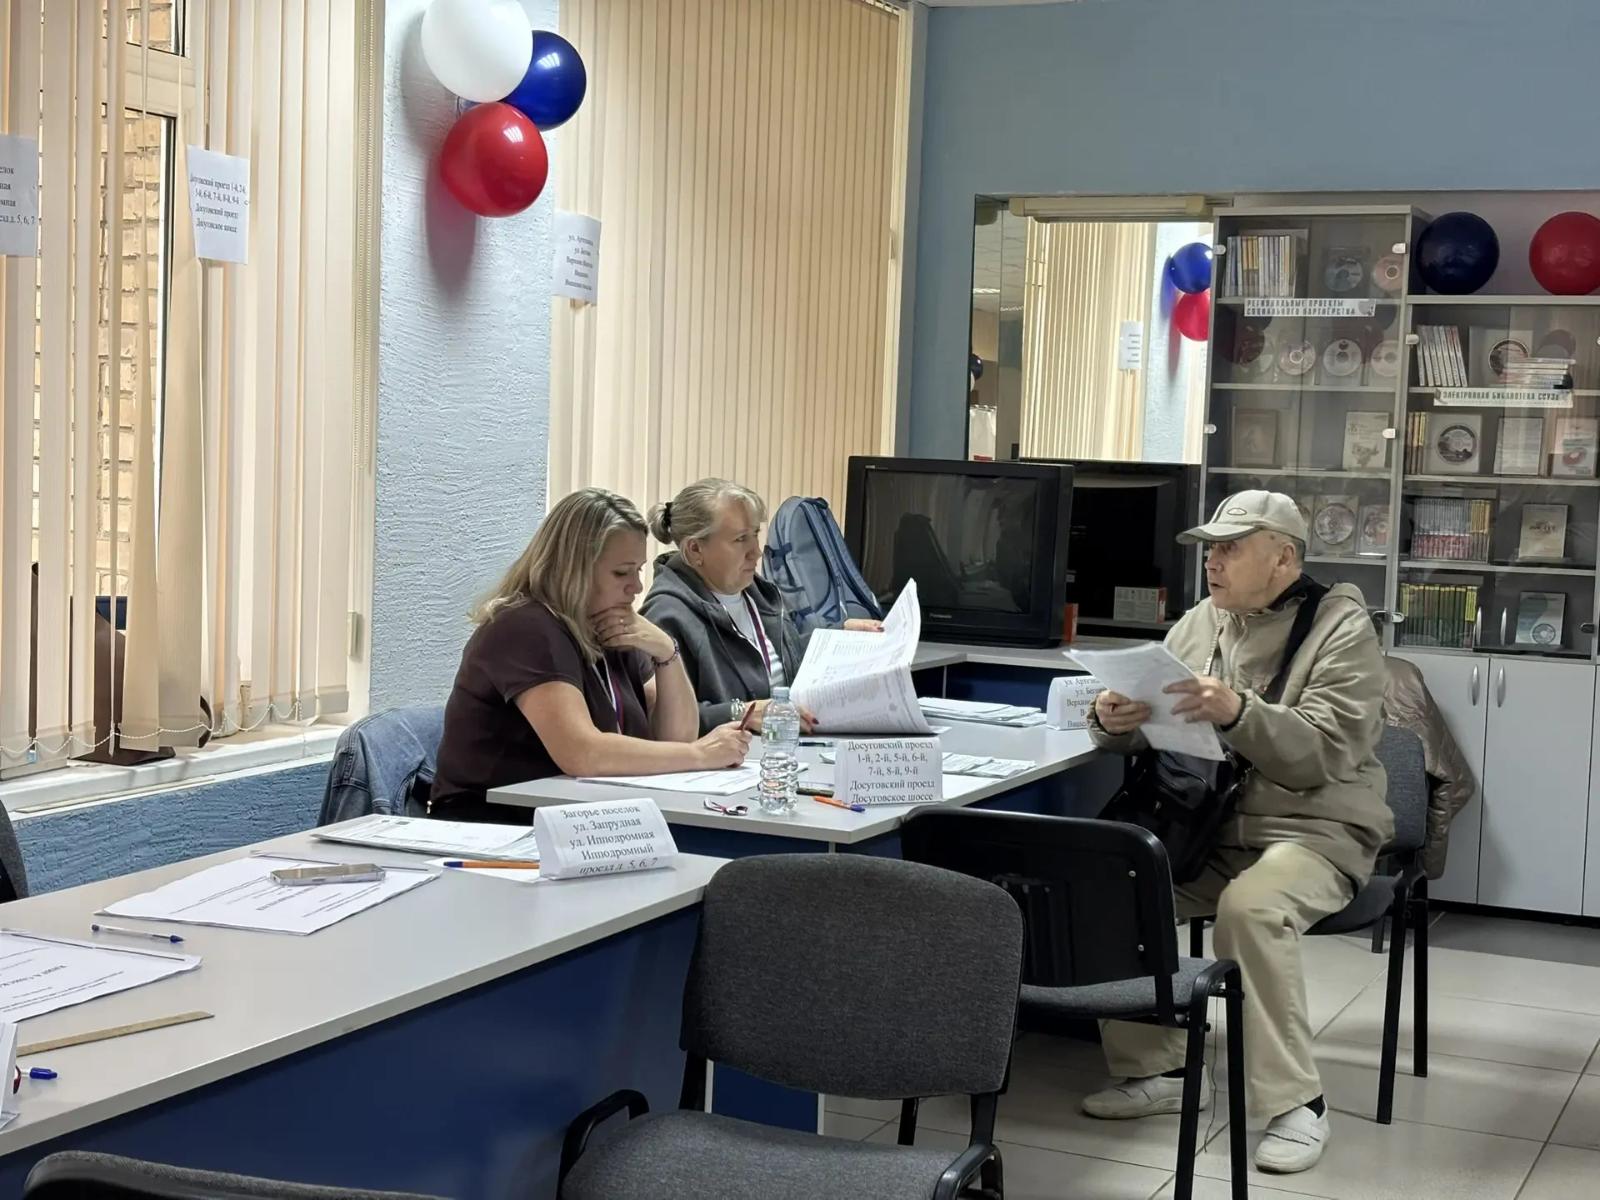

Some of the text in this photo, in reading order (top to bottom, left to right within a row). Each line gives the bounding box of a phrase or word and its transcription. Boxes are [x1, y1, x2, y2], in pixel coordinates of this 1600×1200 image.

[848, 741, 934, 751] Досуговский проезд
[858, 753, 928, 763] 1-й, 2-й, 5-й, 6-й,
[868, 767, 919, 776] 7-й, 8-й, 9-й
[850, 781, 935, 791] Досуговский проезд
[852, 794, 906, 804] Досуговское
[560, 805, 641, 819] Загорье поселок
[573, 817, 642, 834] ул. Запрудная
[569, 831, 656, 850] ул. Ипподромная
[582, 845, 655, 861] Ипподромный
